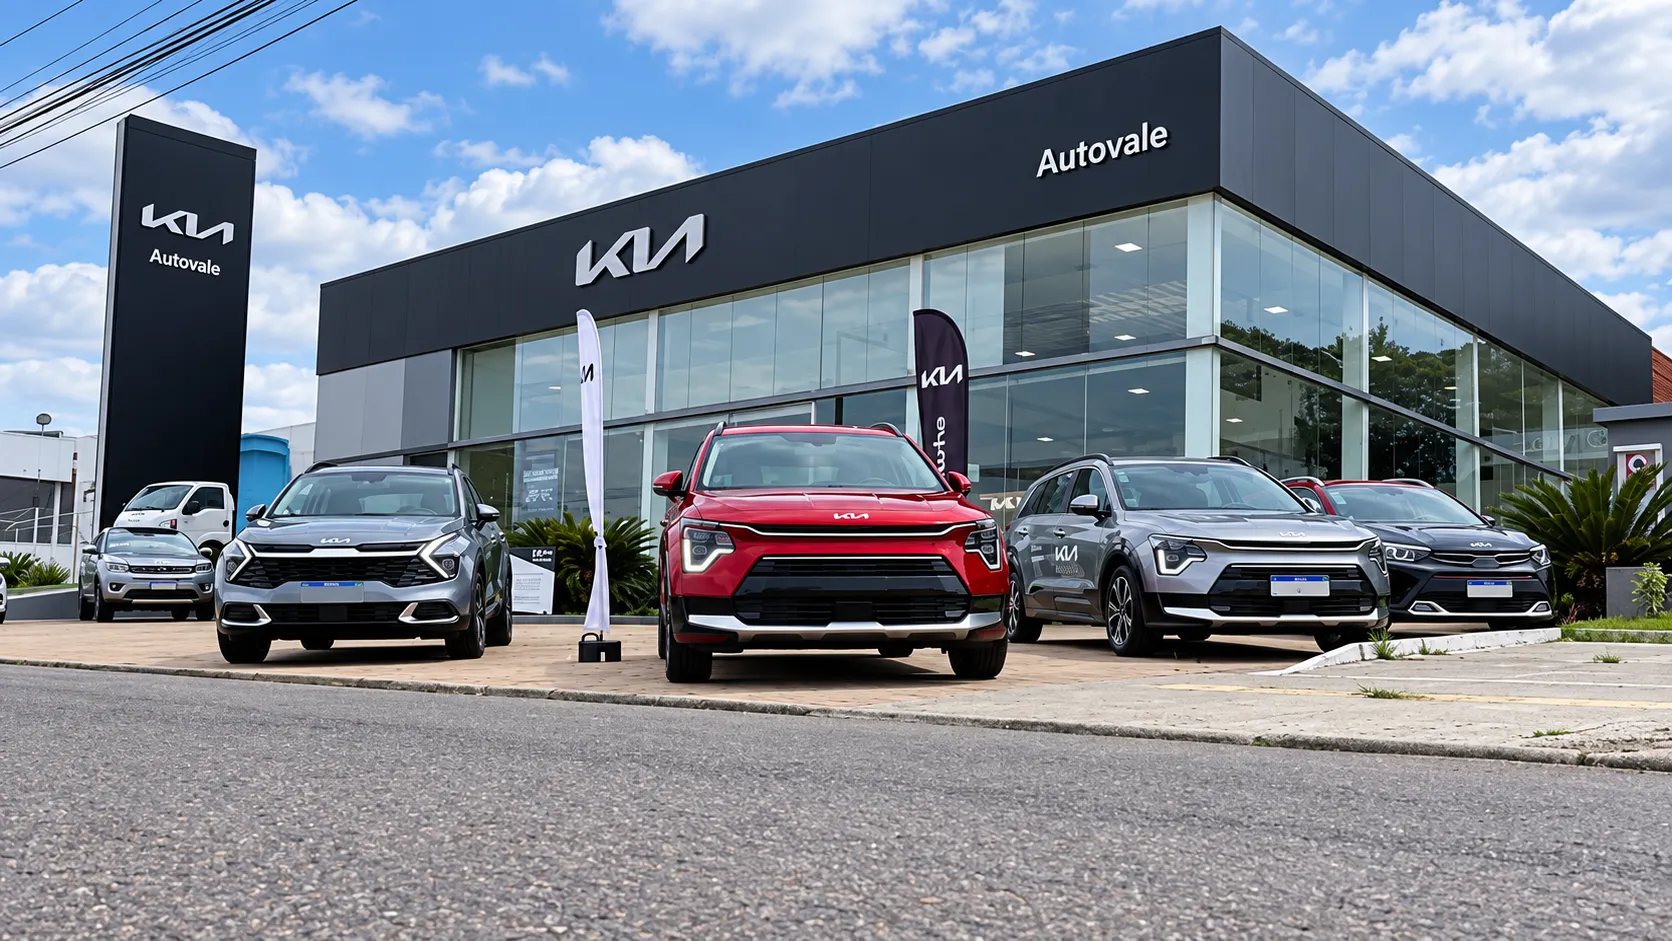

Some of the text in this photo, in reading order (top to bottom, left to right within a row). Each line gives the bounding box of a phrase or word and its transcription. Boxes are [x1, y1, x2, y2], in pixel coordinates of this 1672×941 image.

[1036, 121, 1168, 177] Autovale
[141, 203, 234, 245] KIA
[149, 248, 221, 276] Autovale
[575, 213, 704, 287] KIA
[921, 364, 963, 389] KIA
[1055, 544, 1078, 561] KIA
